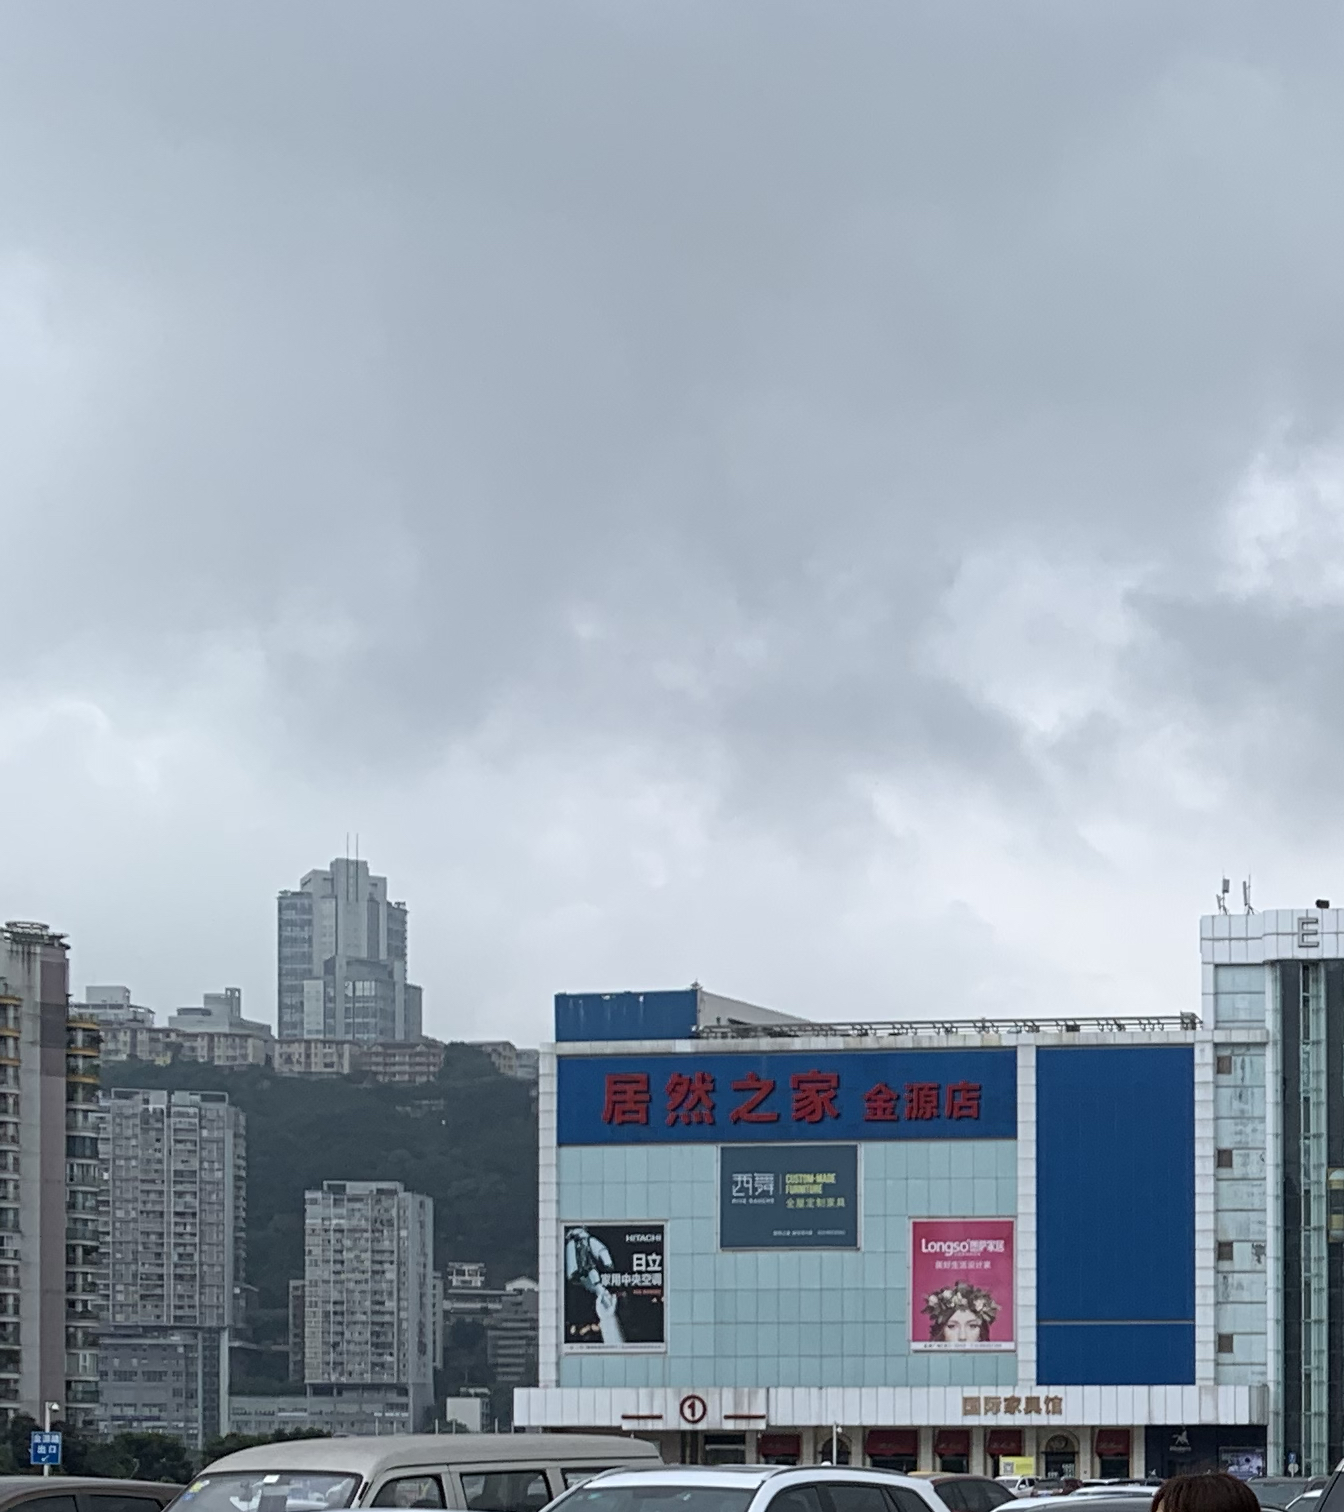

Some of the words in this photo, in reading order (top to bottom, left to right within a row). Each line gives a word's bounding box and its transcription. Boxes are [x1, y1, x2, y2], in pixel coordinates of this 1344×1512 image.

[1298, 916, 1319, 948] E
[602, 1070, 840, 1125] 居然之家
[863, 1082, 982, 1121] 金源店
[626, 1234, 662, 1242] HITACHI
[921, 1238, 968, 1257] Longso
[633, 1253, 662, 1271] 日立
[600, 1273, 662, 1287] 家用中央空调
[962, 1394, 1063, 1416] 国际家具馆
